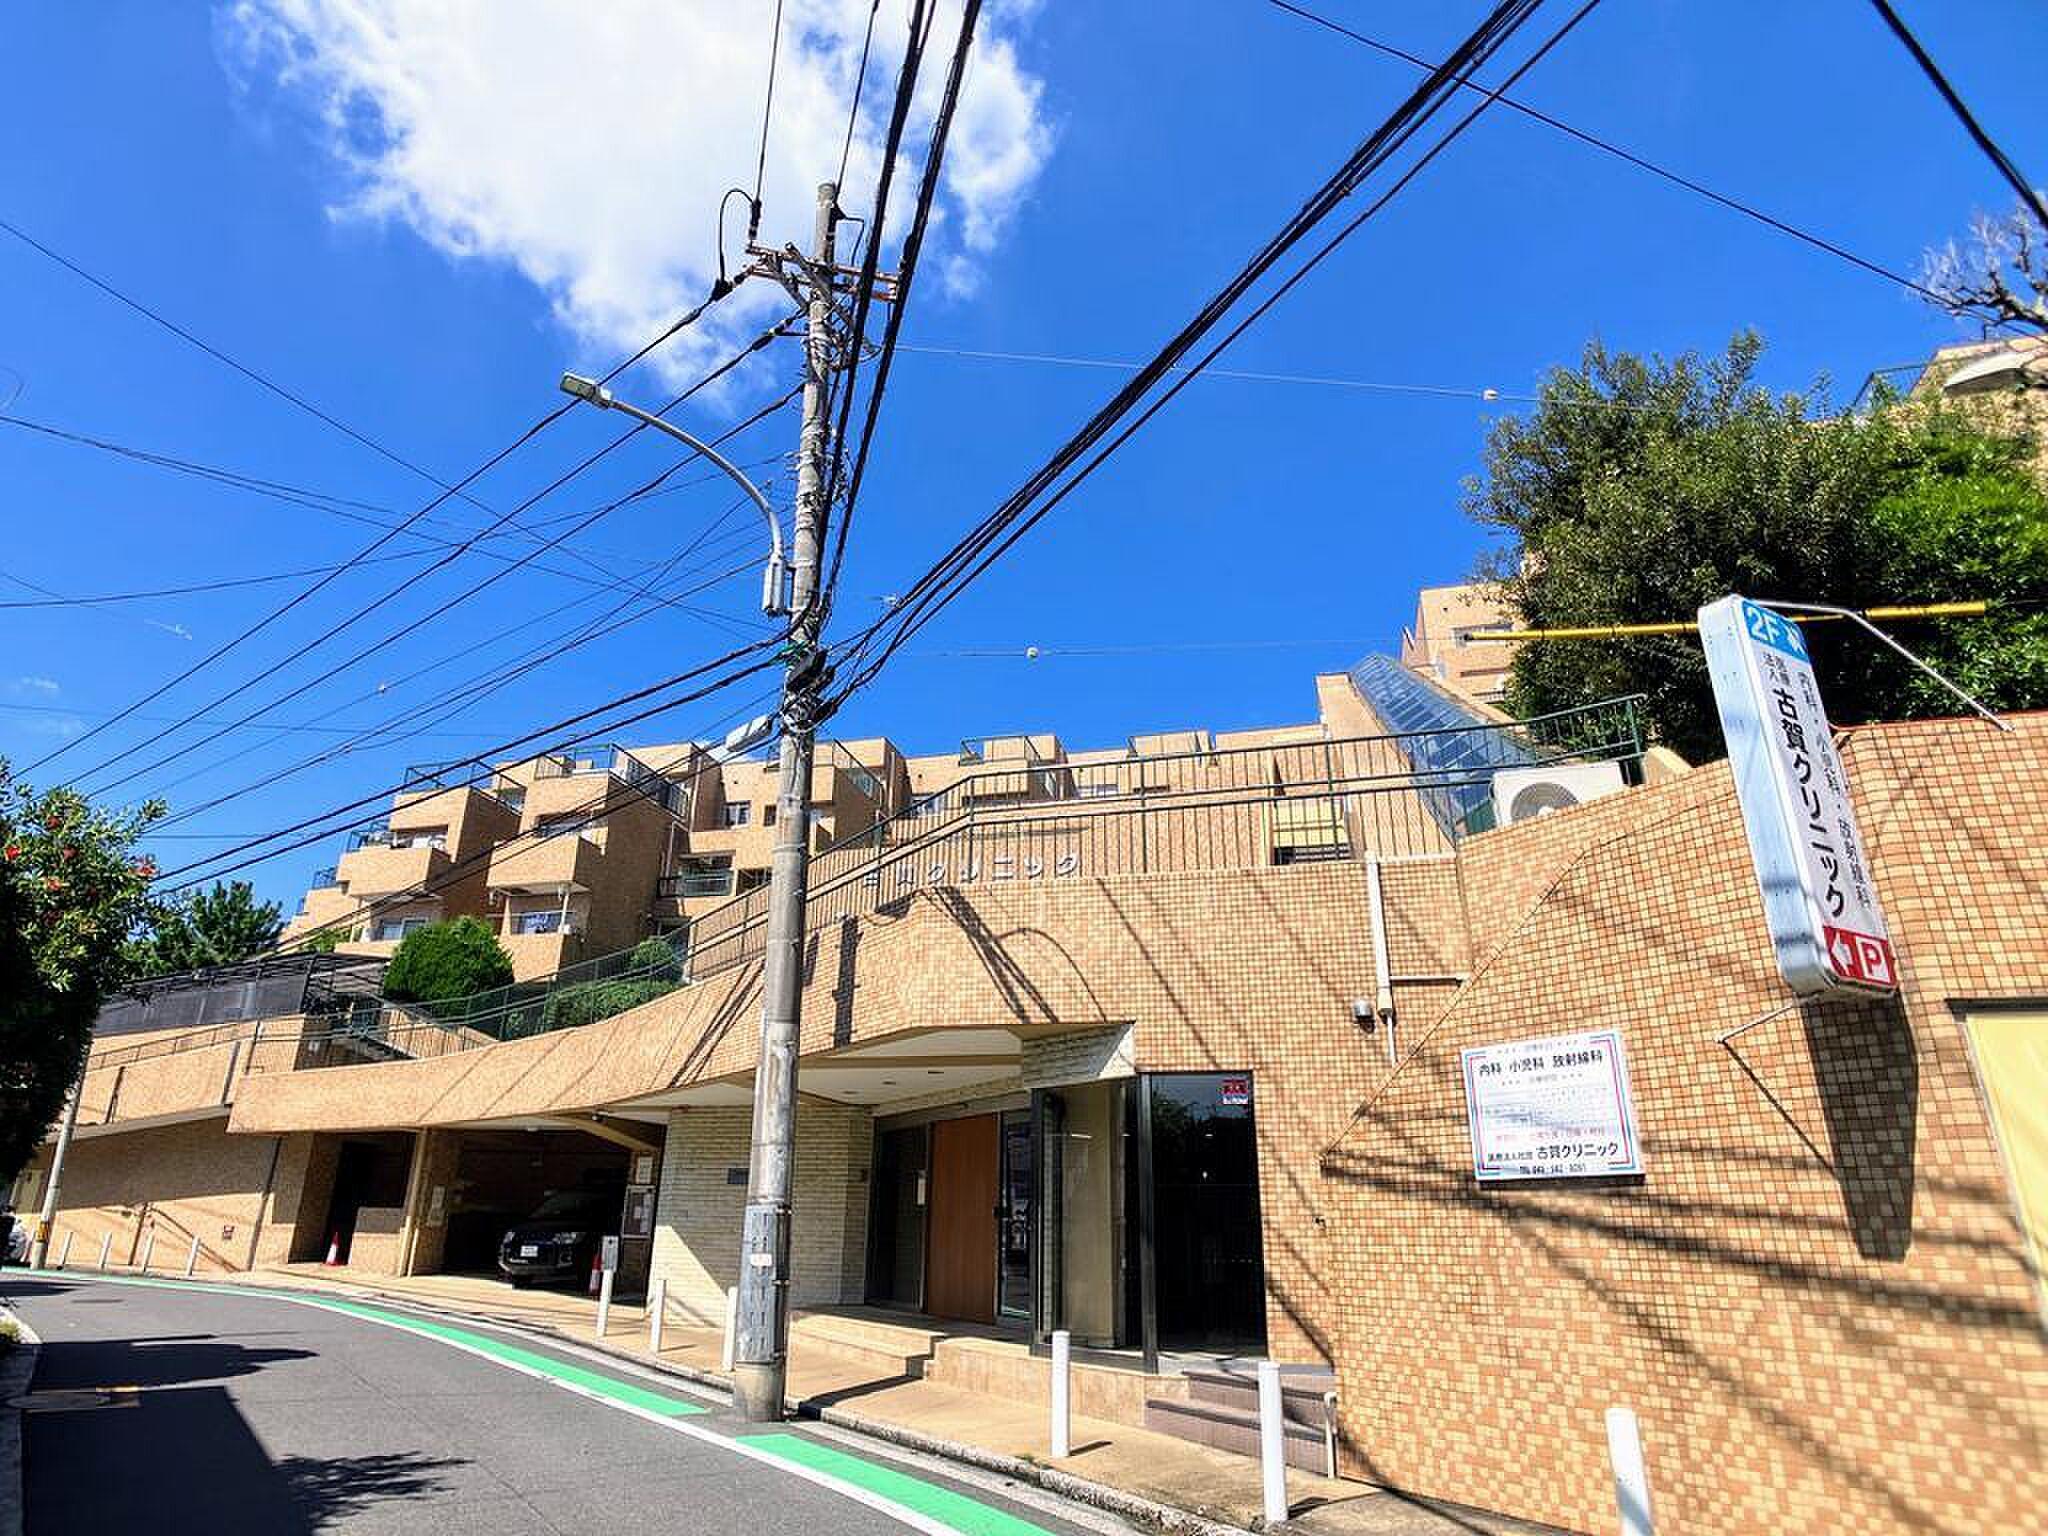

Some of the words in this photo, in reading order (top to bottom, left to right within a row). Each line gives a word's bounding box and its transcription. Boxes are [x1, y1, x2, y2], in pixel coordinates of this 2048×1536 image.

[1746, 607, 1780, 644] 2F
[1772, 687, 1844, 918] 古賀クリニック
[1862, 943, 1881, 974] P
[1479, 1062, 1501, 1077] 内科
[1508, 1056, 1545, 1073] 小児科
[1536, 1141, 1619, 1160] 古賀クリニック
